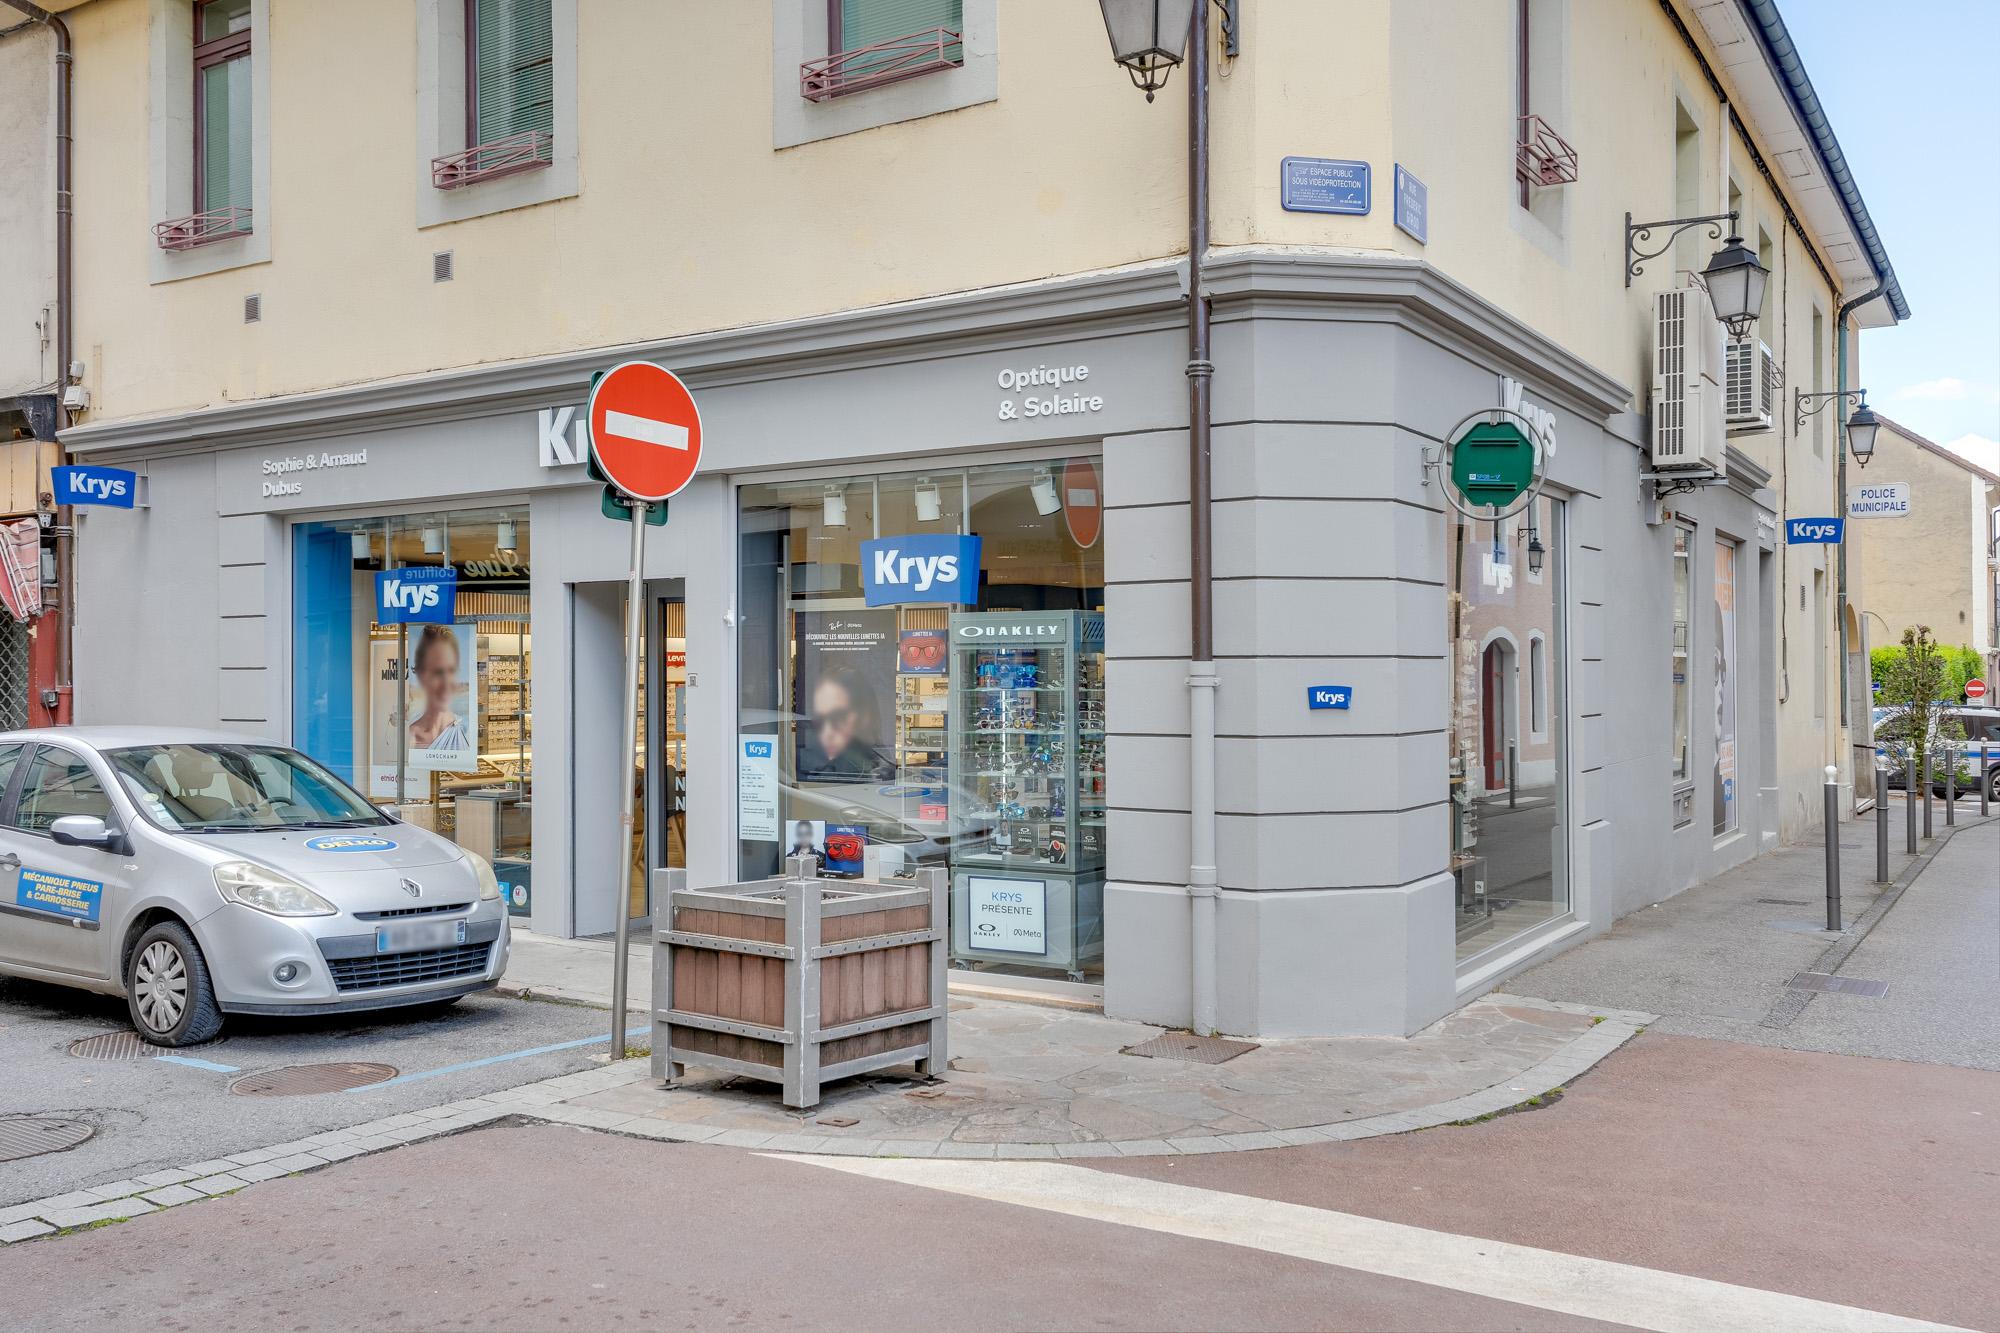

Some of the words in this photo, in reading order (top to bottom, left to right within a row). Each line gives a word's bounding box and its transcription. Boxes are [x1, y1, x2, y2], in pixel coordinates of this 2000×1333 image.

[1310, 167, 1332, 177] ESPACE
[1333, 169, 1353, 178] PUBLIC
[1292, 177, 1308, 185] SOUS
[998, 365, 1089, 393] Optique
[998, 400, 1019, 421] &
[1024, 392, 1104, 418] Solaire
[262, 456, 304, 477] Sophie
[306, 454, 318, 470] &
[319, 448, 368, 468] Arnaud
[69, 471, 128, 500] Krys
[262, 480, 303, 497] Dubus
[1861, 488, 1896, 499] POLICE
[1851, 501, 1907, 513] MUNICIPALE
[1793, 522, 1836, 540] Krys
[874, 549, 959, 592] Krys
[383, 579, 439, 614] Krys
[985, 625, 1058, 637] OAKLEY
[1316, 691, 1345, 705] Krys
[749, 744, 768, 755] Krys
[22, 871, 71, 887] MÉCANIQUE
[71, 880, 100, 893] PNEUS
[35, 883, 82, 899] PARE-BRISE
[991, 891, 1023, 903] KRYS
[26, 890, 34, 899] &
[34, 892, 90, 910] CARROSSERIE
[981, 904, 1033, 916] PRÉSENTE
[1023, 930, 1042, 938] Meta
